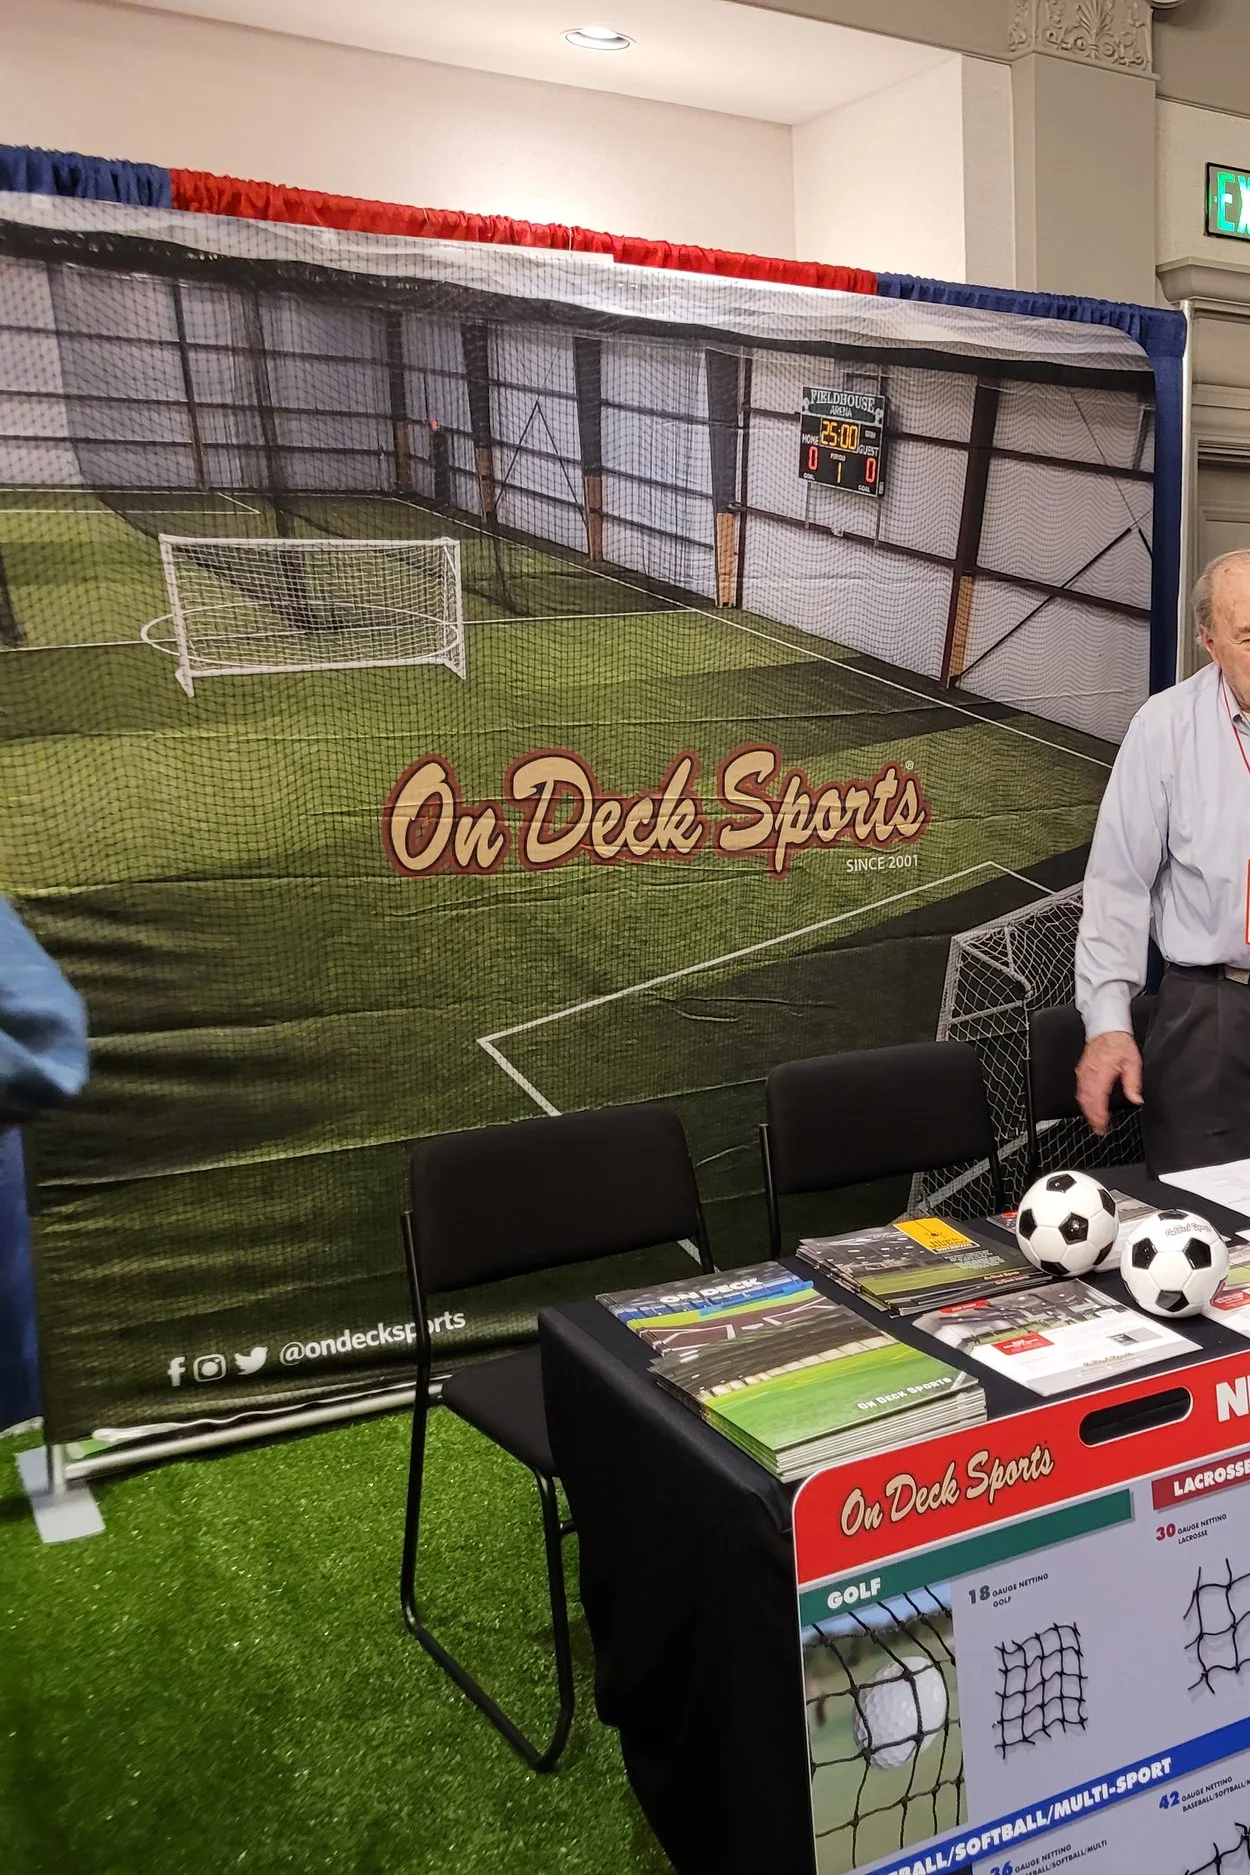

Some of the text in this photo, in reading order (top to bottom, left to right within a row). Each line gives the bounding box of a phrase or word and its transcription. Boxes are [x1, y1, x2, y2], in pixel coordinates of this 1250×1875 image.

[810, 389, 876, 414] FIELDHOUSE
[829, 405, 853, 417] ARENA
[802, 433, 879, 457] HOME GUEST
[821, 420, 859, 451] 25:00
[808, 446, 877, 483] 0 0
[386, 746, 931, 877] On Deck Sports
[846, 854, 919, 873] SINCE 2001
[660, 1278, 763, 1303] ON DECK
[840, 1444, 1055, 1537] On Deck Sports
[1156, 1513, 1227, 1541] 30 GAUGE NETTING
[1178, 1529, 1208, 1544] LACROSSE
[827, 1577, 881, 1610] GOLF
[969, 1572, 1048, 1604] 18 GAUGE NETTING
[993, 1596, 1011, 1608] GOLF
[1159, 1776, 1233, 1809] 42 GAUGE NETTING
[887, 1757, 1172, 1875] BALL/SOFTBALL/MULTI-SPORT
[1015, 1858, 1039, 1873] GAUGE
[1041, 1844, 1071, 1862] NETTING
